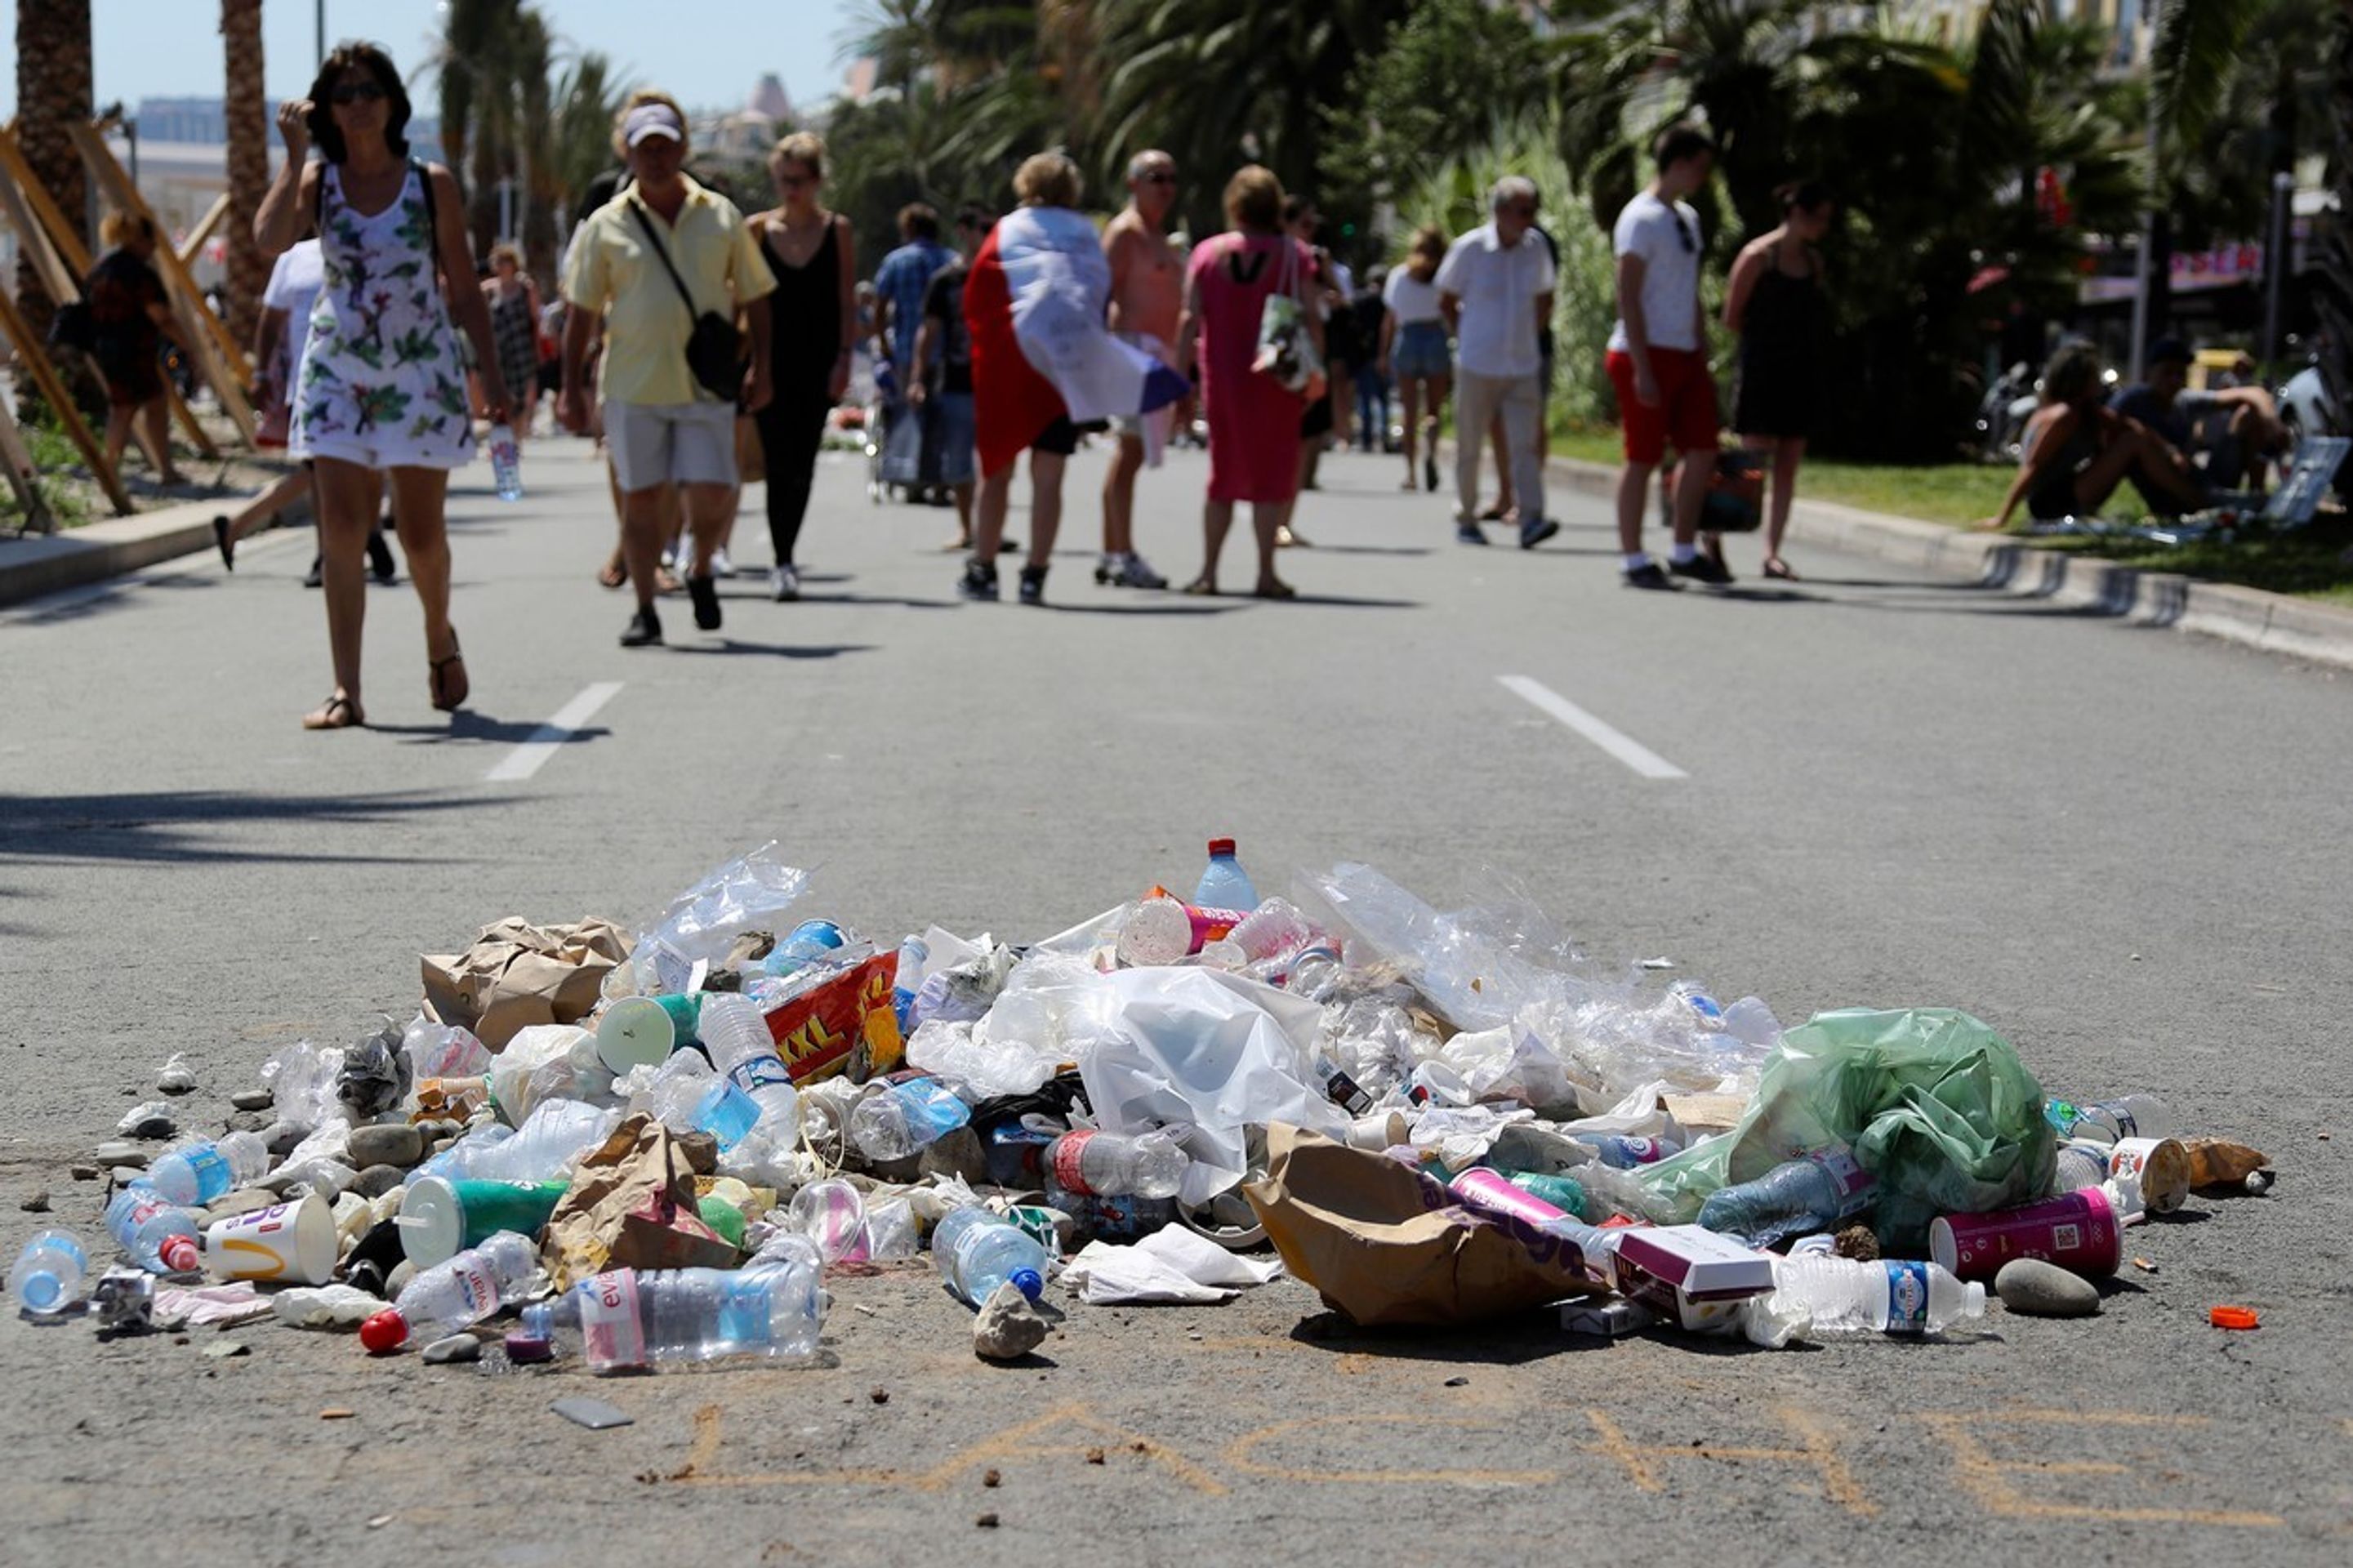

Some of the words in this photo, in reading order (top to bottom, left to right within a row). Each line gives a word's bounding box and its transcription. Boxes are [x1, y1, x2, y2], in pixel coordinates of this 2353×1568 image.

[775, 1013, 846, 1067] XXL
[598, 1272, 621, 1308] evia
[663, 1399, 2284, 1526] LACHE
